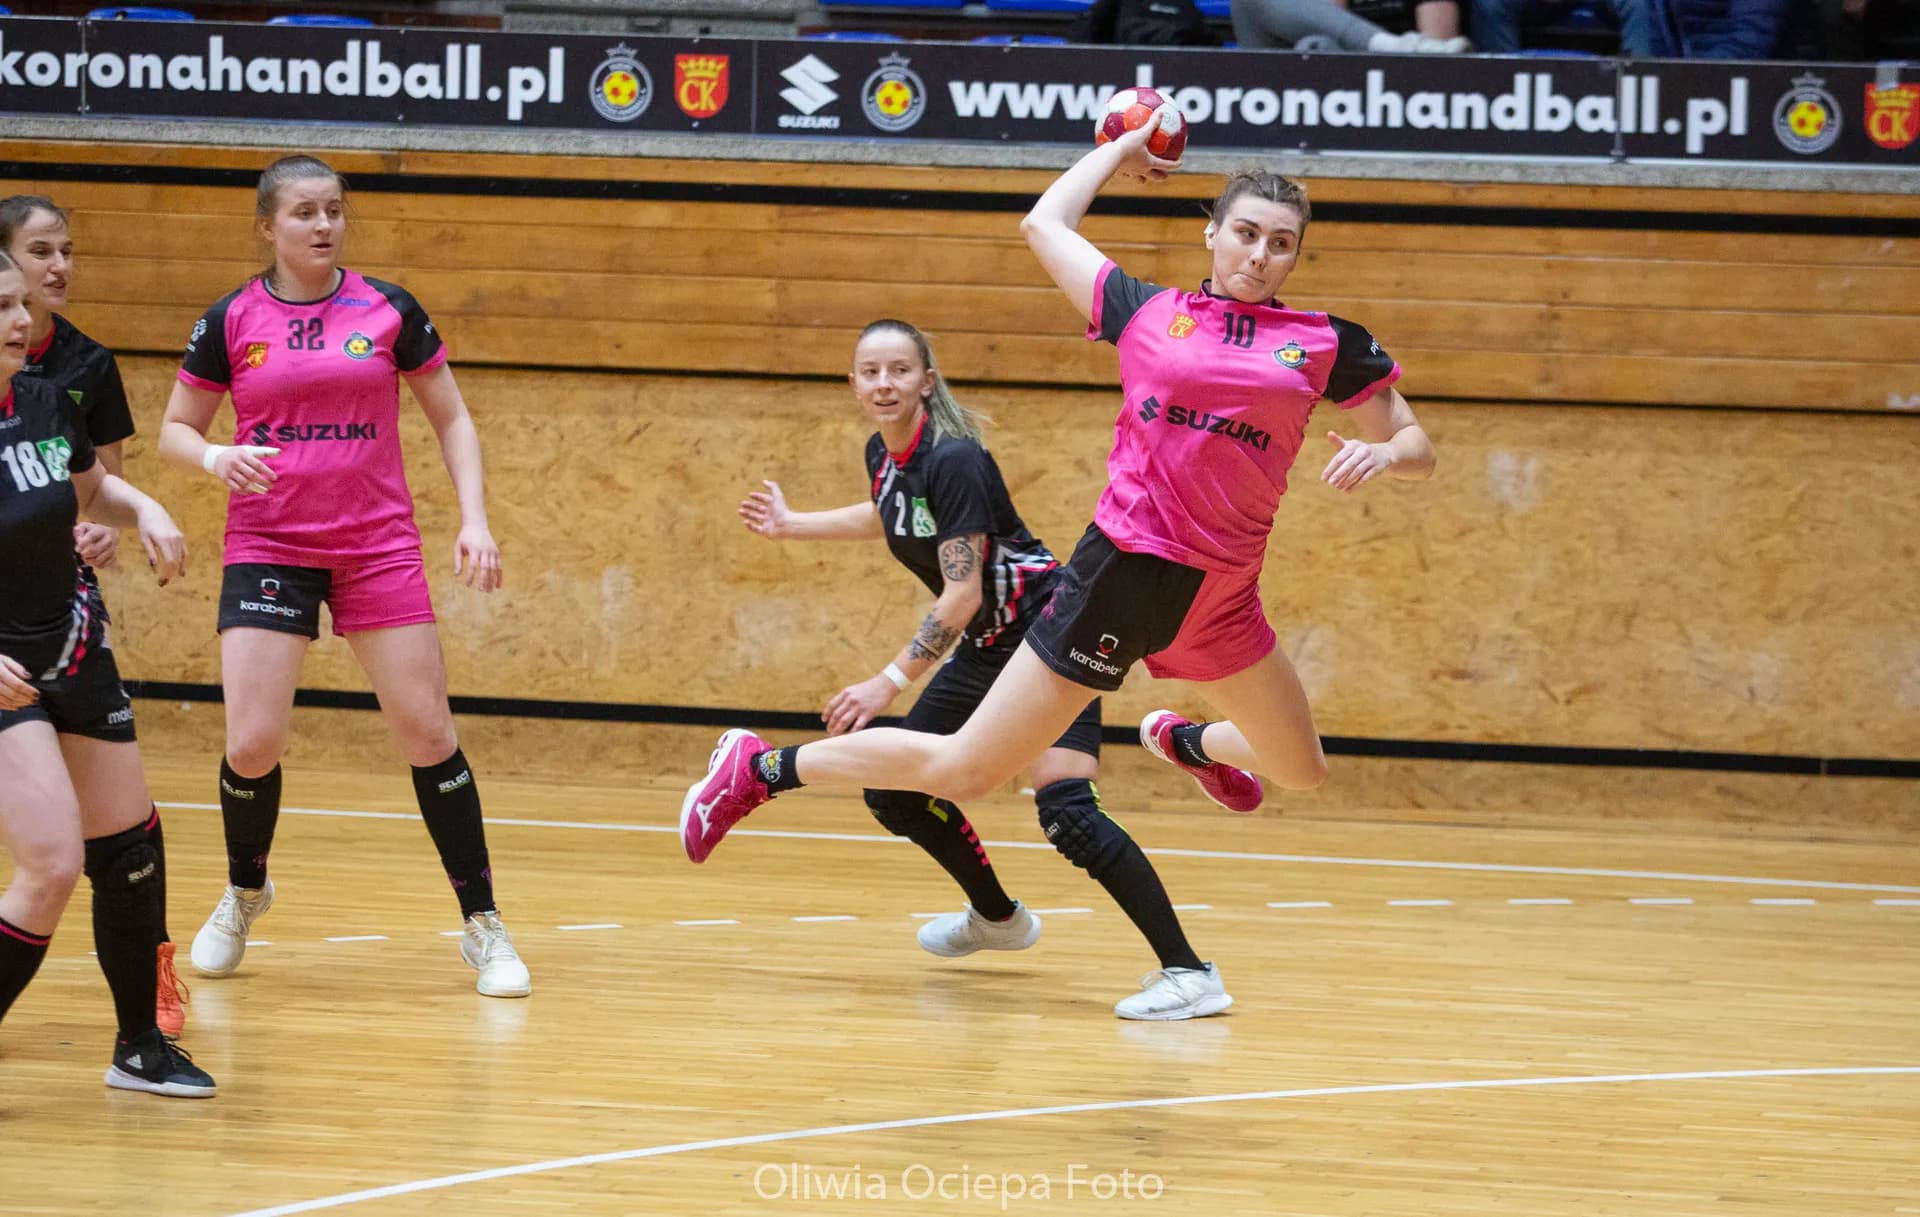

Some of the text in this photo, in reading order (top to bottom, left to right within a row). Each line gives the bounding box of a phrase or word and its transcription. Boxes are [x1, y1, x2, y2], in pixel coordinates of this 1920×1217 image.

[680, 79, 718, 112] CK
[948, 64, 1748, 154] wwworonahandball.pl
[778, 114, 840, 129] SUZUKI
[1869, 108, 1911, 143] CK
[287, 317, 325, 351] 32
[1222, 312, 1256, 349] 10
[277, 423, 376, 442] SUZUKI
[1166, 405, 1271, 452] SUZUKI
[0, 441, 50, 492] 18
[894, 491, 907, 536] 2
[222, 779, 256, 798] SELECT
[438, 770, 469, 790] SELECT
